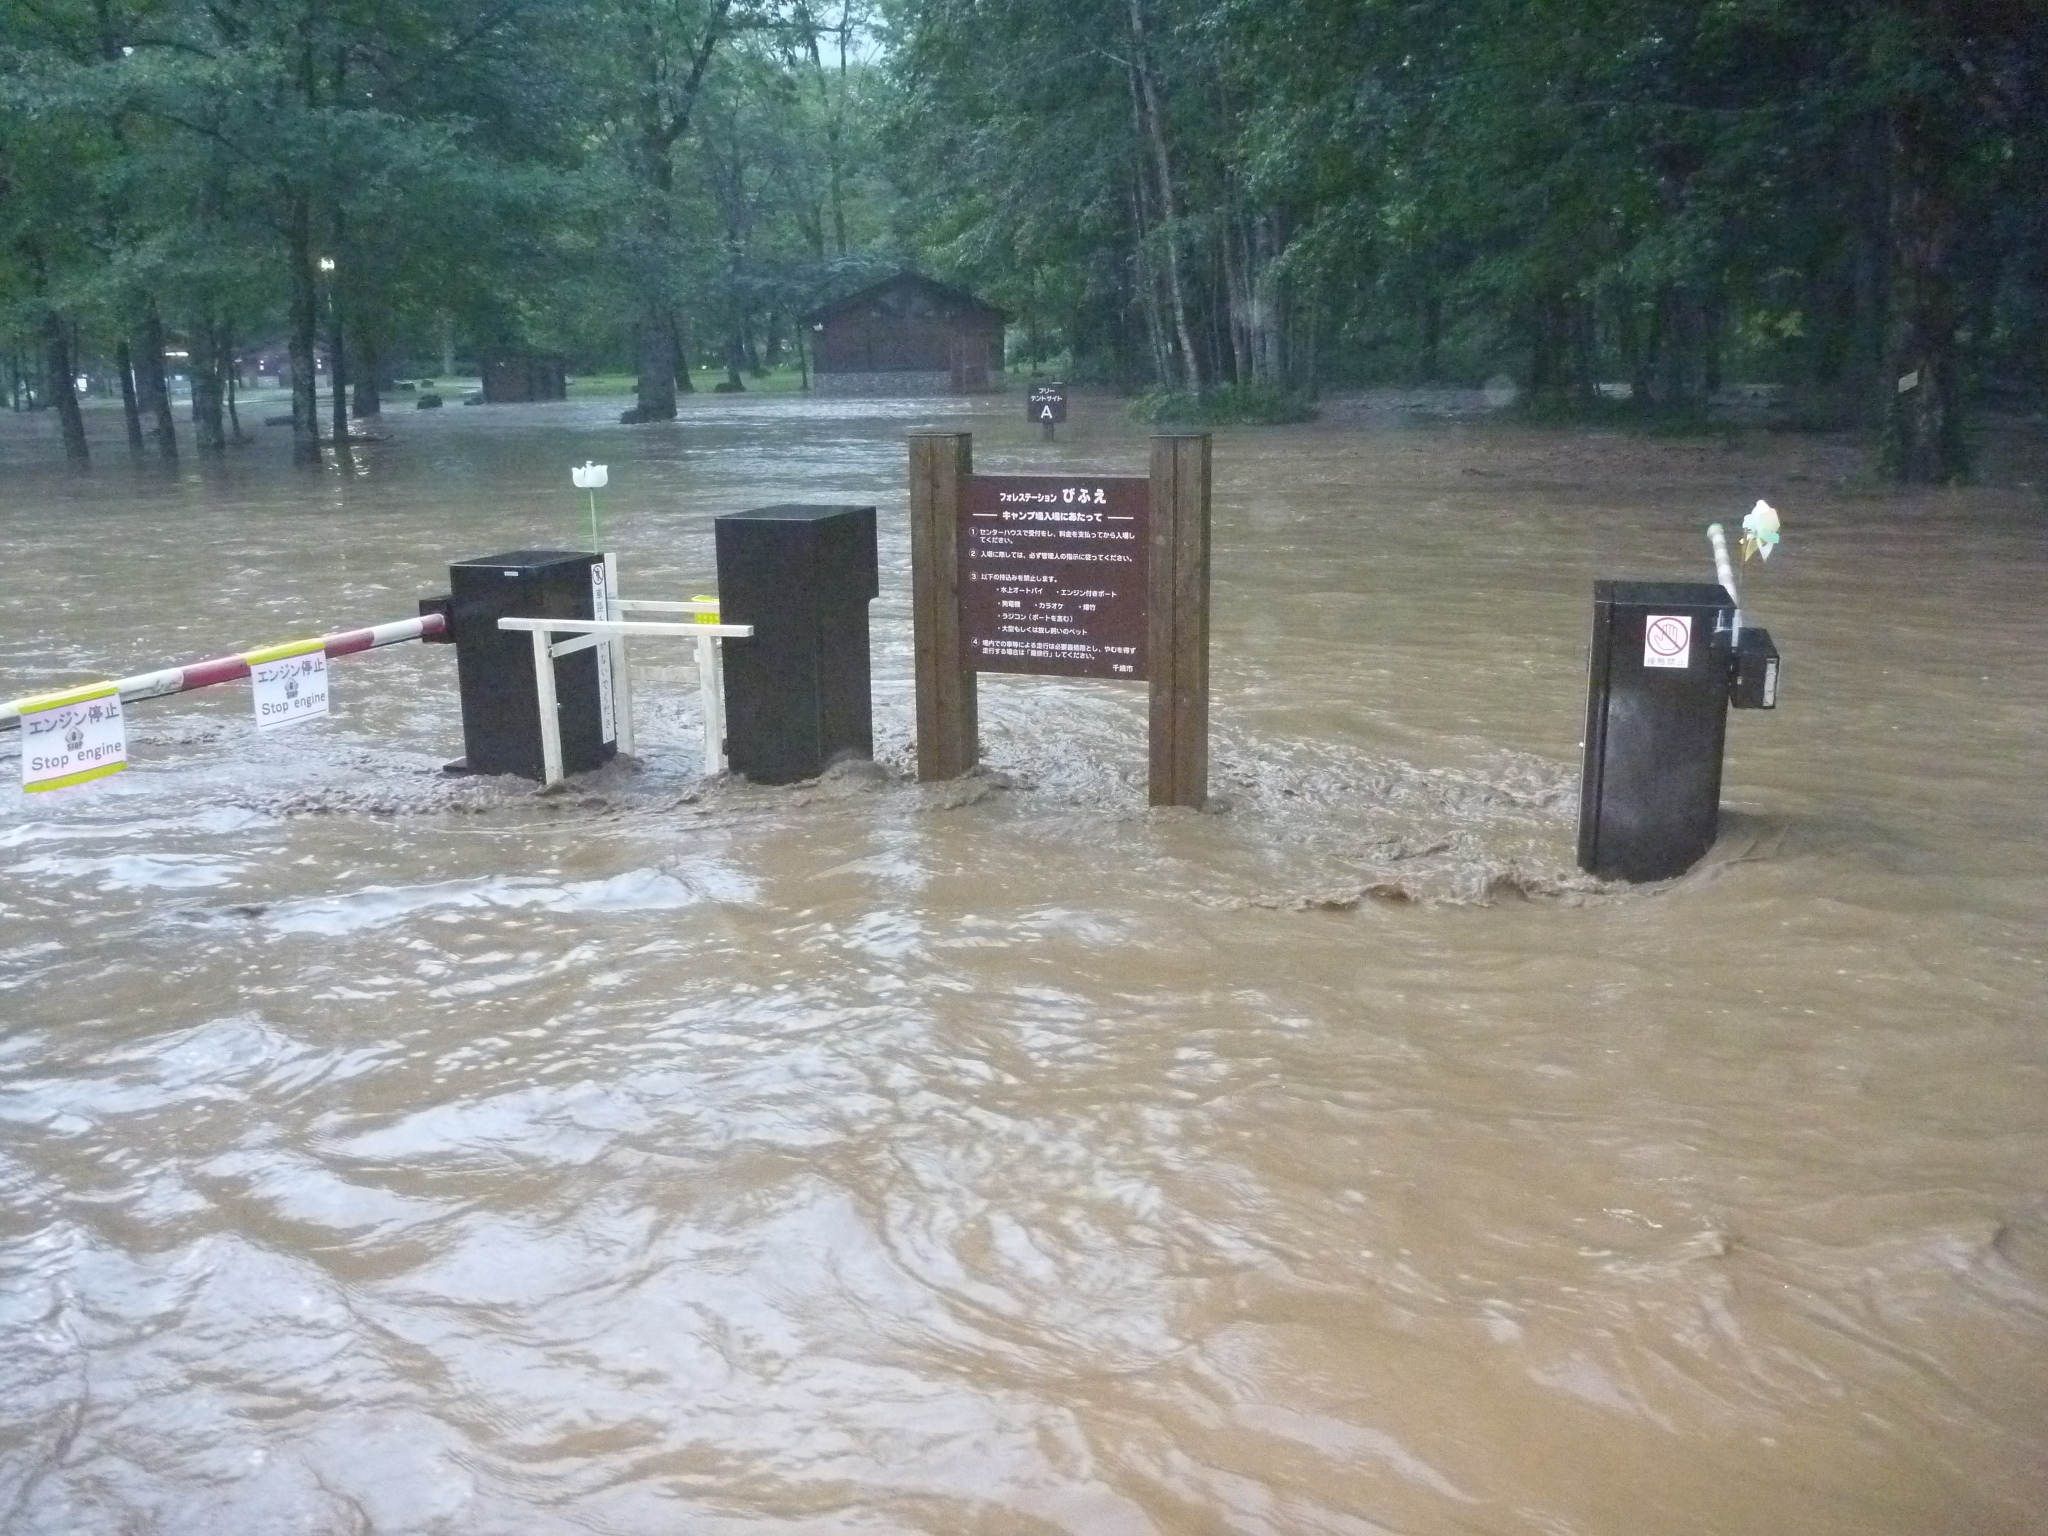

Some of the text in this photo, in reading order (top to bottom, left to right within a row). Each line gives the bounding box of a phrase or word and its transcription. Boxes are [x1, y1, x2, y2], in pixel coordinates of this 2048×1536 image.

[1040, 405, 1053, 419] A
[999, 487, 1107, 504] フォレステーション びふえ
[1002, 511, 1103, 523] キャンプ場入場にあたって
[979, 536, 1014, 544] てください。
[981, 573, 1058, 583] 以下の持込みを禁止します。
[258, 658, 326, 683] エンジン停止
[1112, 664, 1134, 673] 千歳市
[261, 690, 326, 717] Stop engine
[29, 701, 120, 735] エンジン停止
[67, 740, 84, 752] STOP
[31, 740, 122, 772] Stop engine
